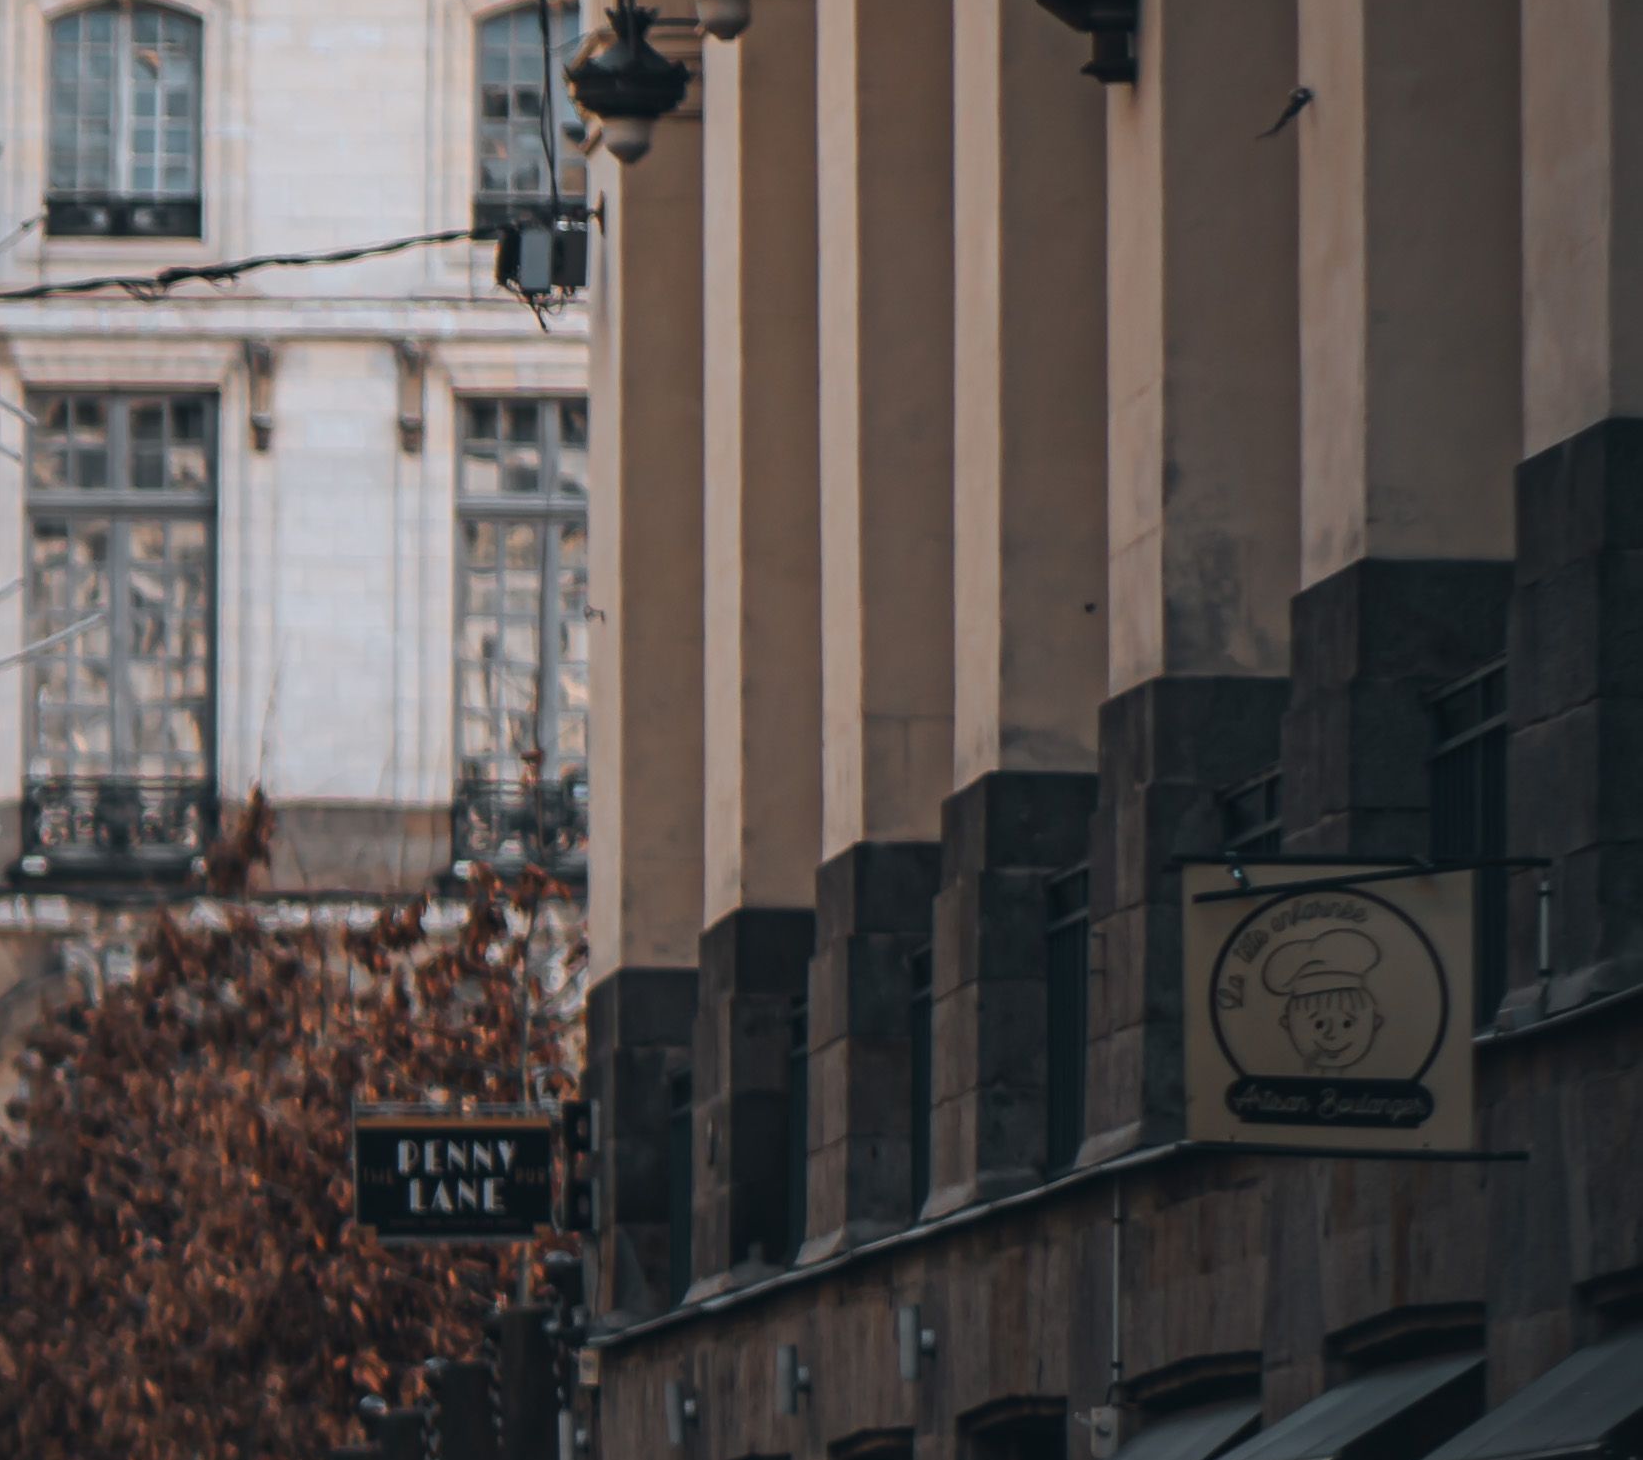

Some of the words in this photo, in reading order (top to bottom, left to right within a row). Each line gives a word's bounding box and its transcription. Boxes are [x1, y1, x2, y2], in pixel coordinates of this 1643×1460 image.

[1232, 1081, 1311, 1113] Artisan
[1315, 1086, 1428, 1124] Boulanger
[397, 1138, 520, 1177] PENNY
[408, 1175, 509, 1216] LANE
